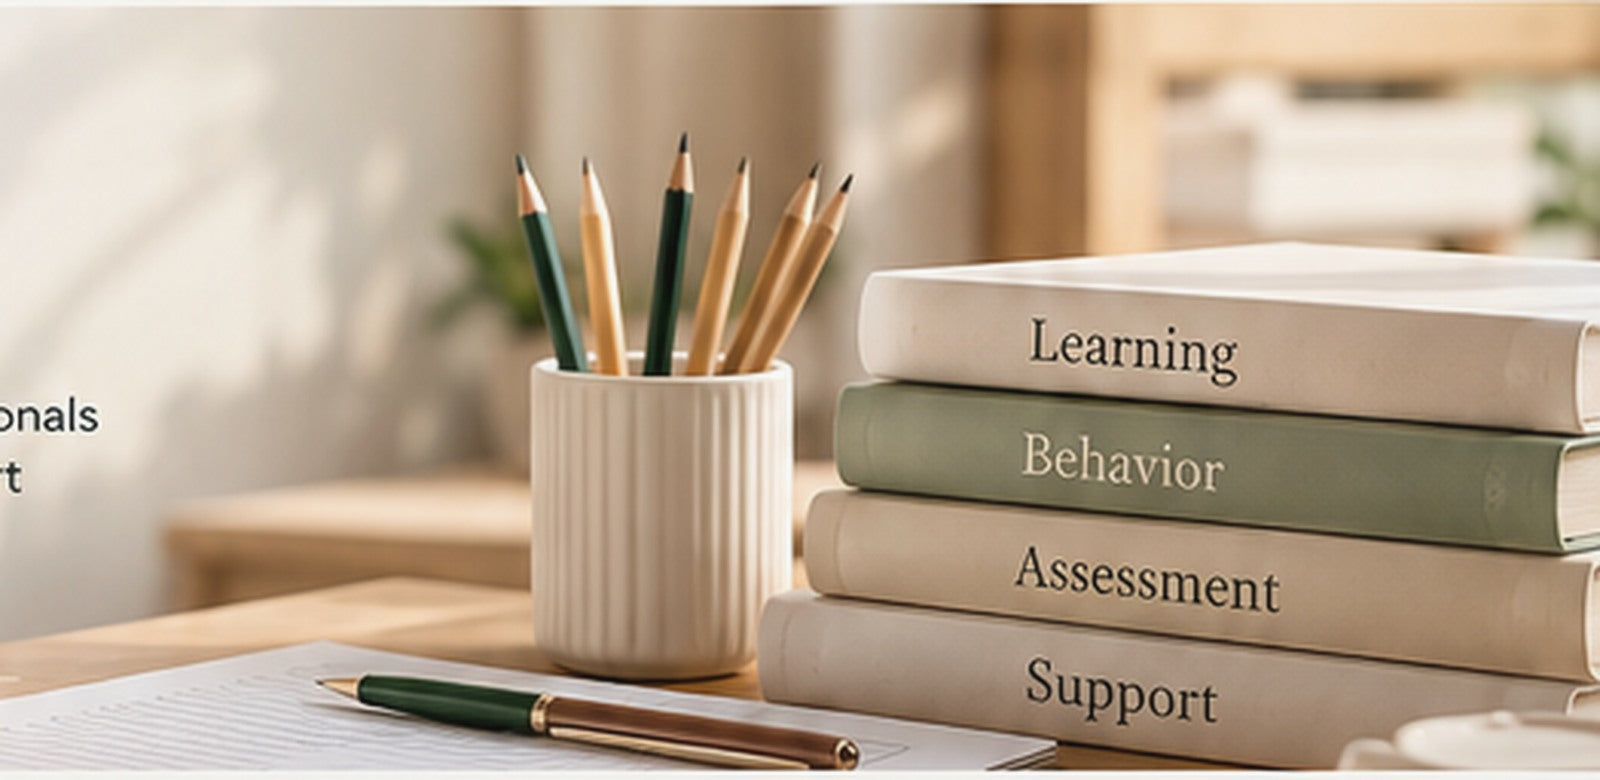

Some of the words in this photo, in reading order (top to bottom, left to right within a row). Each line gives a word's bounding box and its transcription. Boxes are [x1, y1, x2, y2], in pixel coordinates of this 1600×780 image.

[1030, 318, 1238, 387] Learning
[1022, 432, 1225, 492] Behavior
[1015, 546, 1280, 613] Assessment
[1026, 657, 1218, 726] Support
